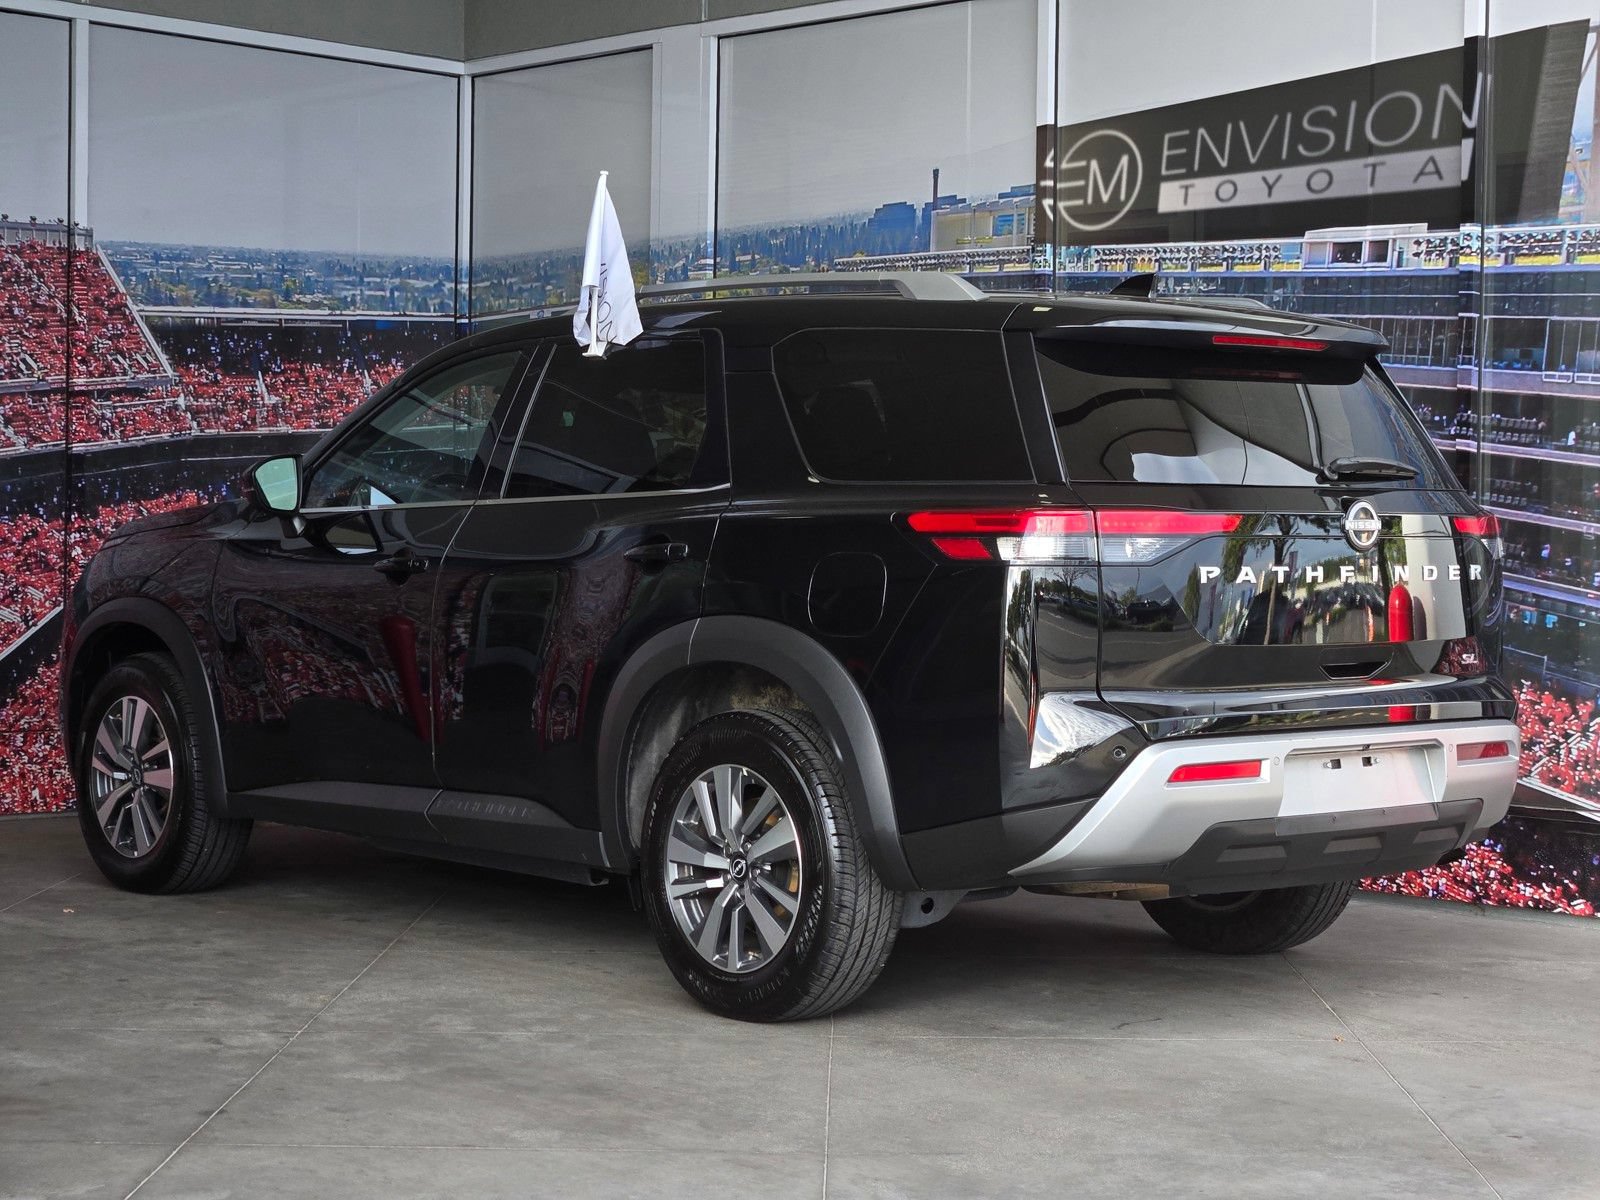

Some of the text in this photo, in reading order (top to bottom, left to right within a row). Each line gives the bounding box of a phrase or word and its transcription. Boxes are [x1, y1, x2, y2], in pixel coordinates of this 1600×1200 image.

[1160, 71, 1483, 177] ENVISION
[1178, 154, 1444, 206] TOYOTA
[1347, 520, 1381, 530] NISSAN
[1199, 564, 1482, 584] PATHFINDER
[1461, 653, 1478, 664] SL
